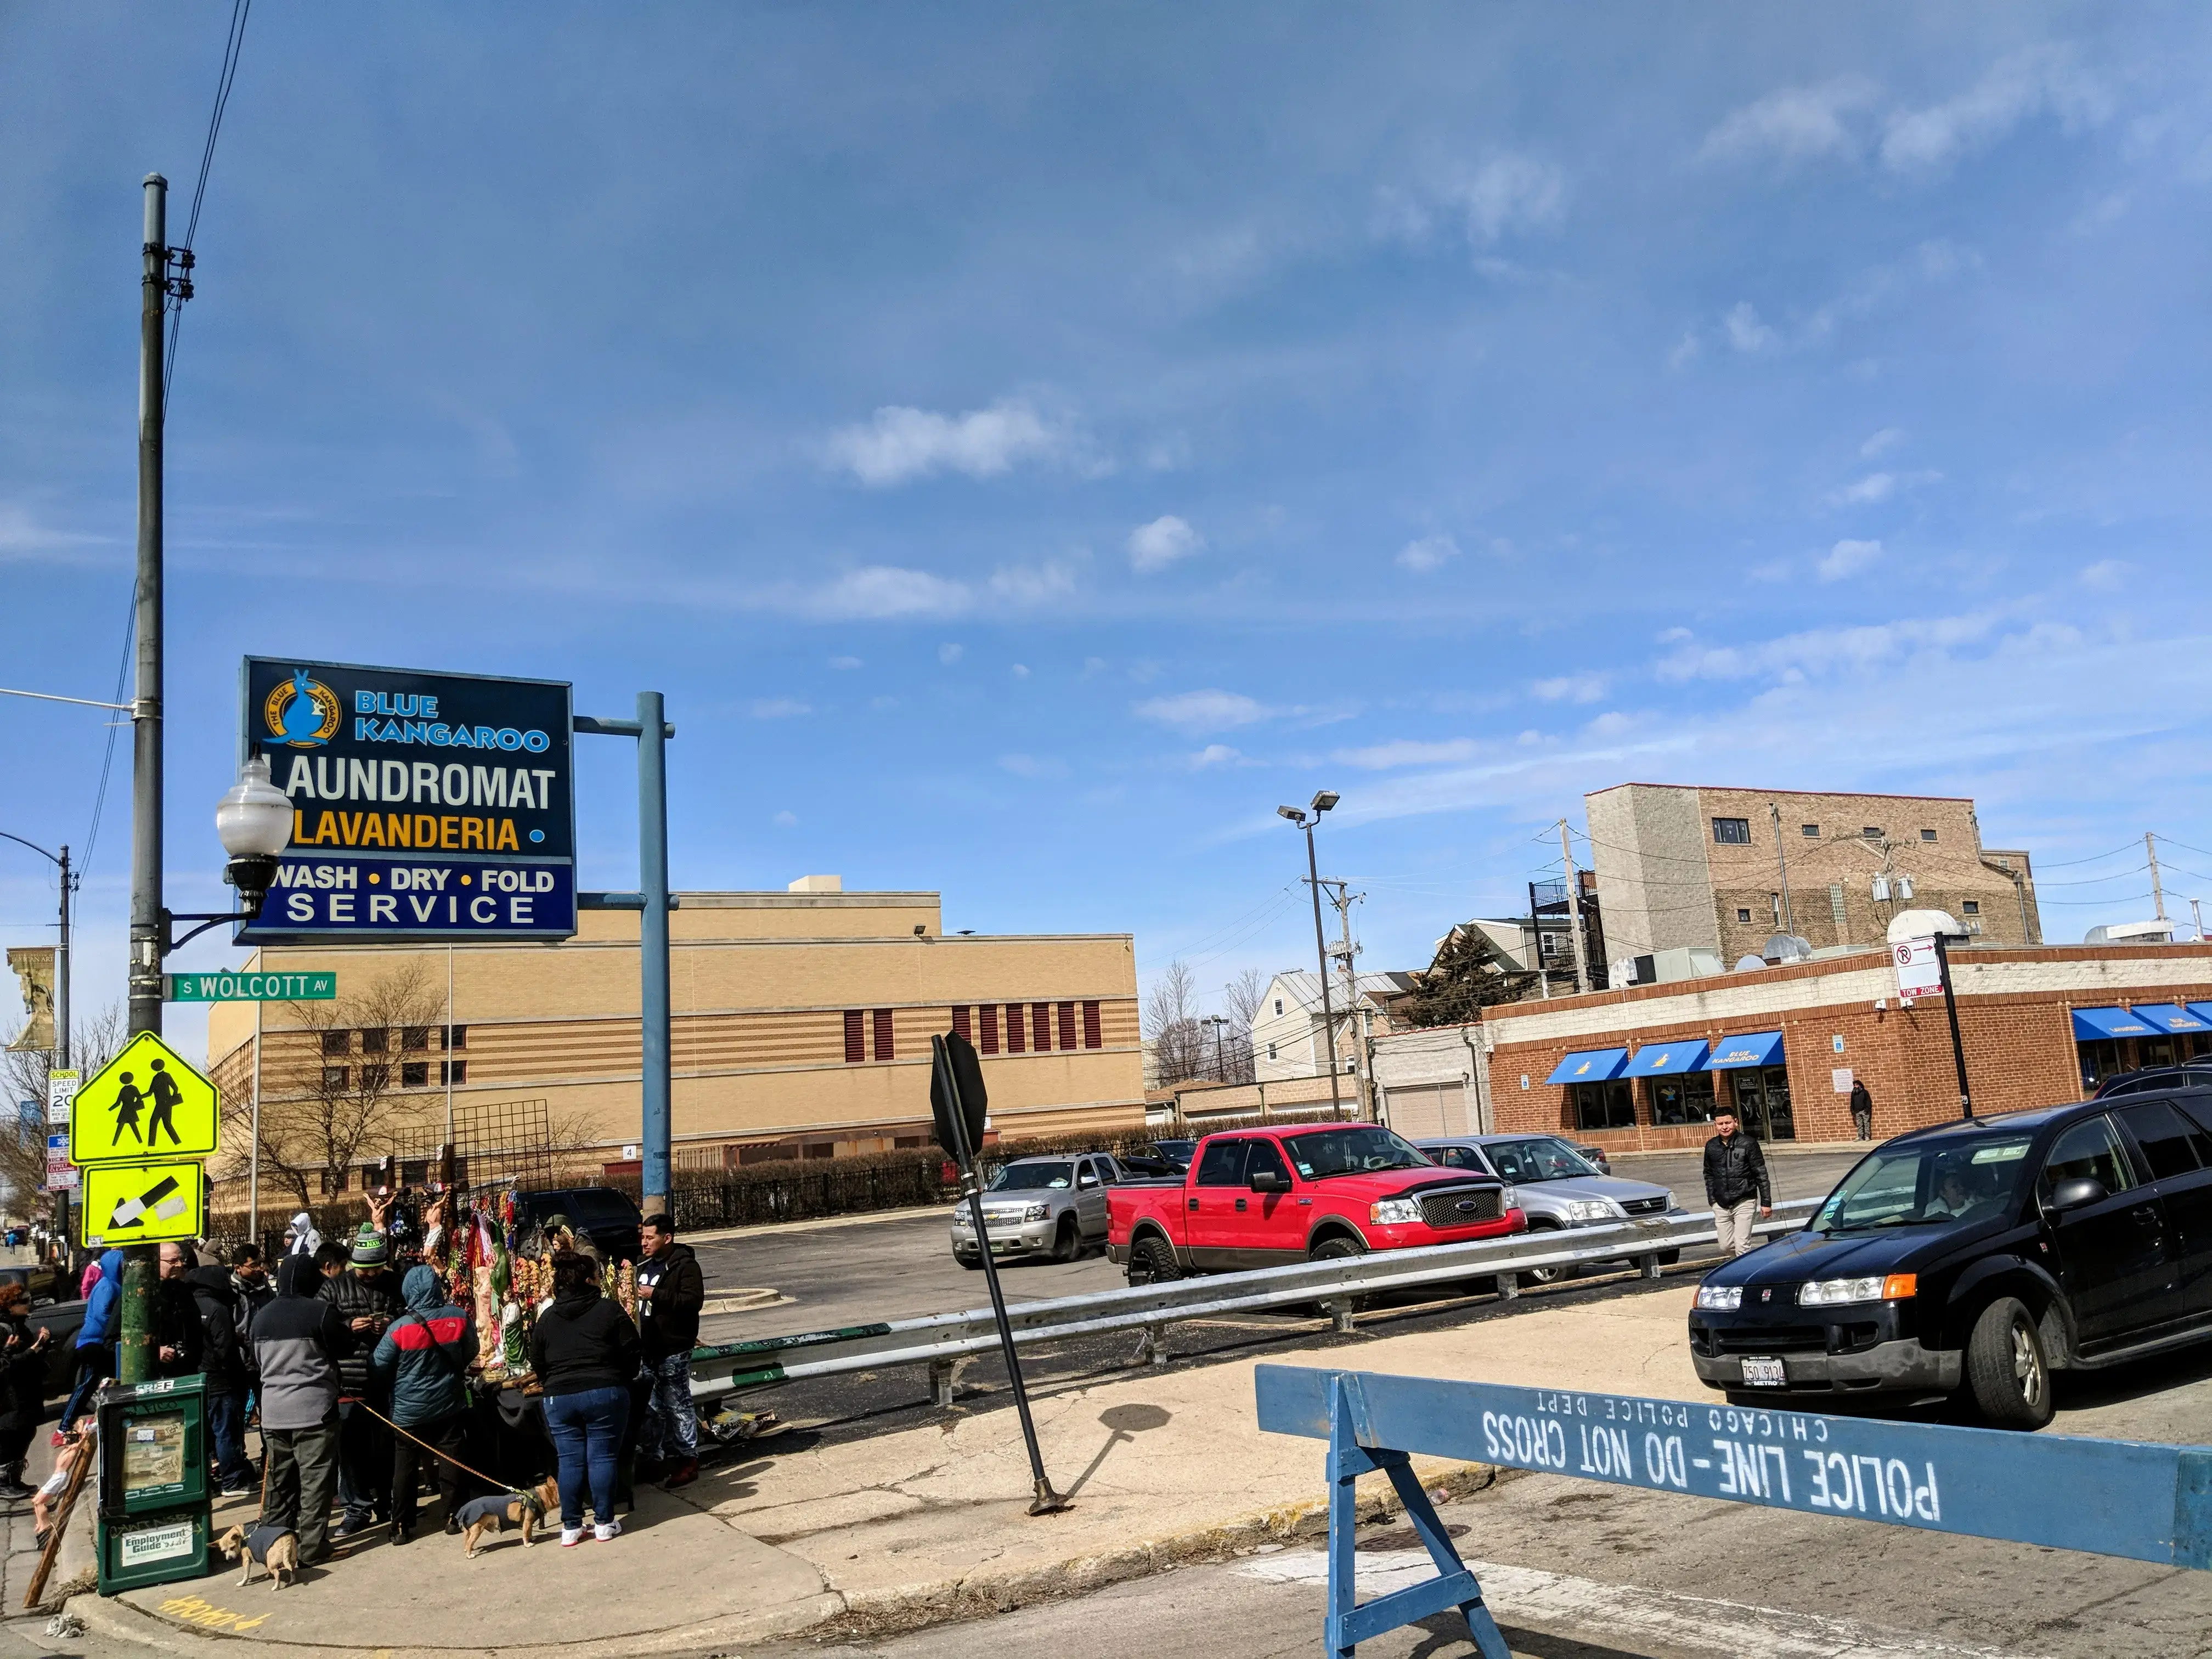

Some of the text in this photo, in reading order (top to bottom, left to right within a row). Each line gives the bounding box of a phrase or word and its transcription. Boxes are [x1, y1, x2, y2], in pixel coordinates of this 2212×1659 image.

[270, 687, 336, 733] THE BLUE KANGAROO
[356, 690, 439, 718] BLUE
[356, 718, 550, 753] KANGAROO
[294, 809, 520, 850] LAVANDERIA
[270, 865, 555, 893] WASH DRY FOLD
[286, 893, 534, 923] SERVICE
[183, 976, 328, 997] S WOLCOTT AV
[1903, 986, 1939, 997] TOW ZONE
[1712, 1054, 1759, 1064] KANGAROO
[627, 1148, 632, 1156] 4
[1743, 1365, 1759, 1380] Z50
[1537, 1392, 1828, 1442] CHICAGO POLICE DEPT
[1483, 1410, 1566, 1468] CROSS
[1580, 1424, 1633, 1480] NOT
[1803, 1450, 1940, 1522] POLICE
[126, 1528, 187, 1547] Employment
[132, 1542, 161, 1553] Guide
